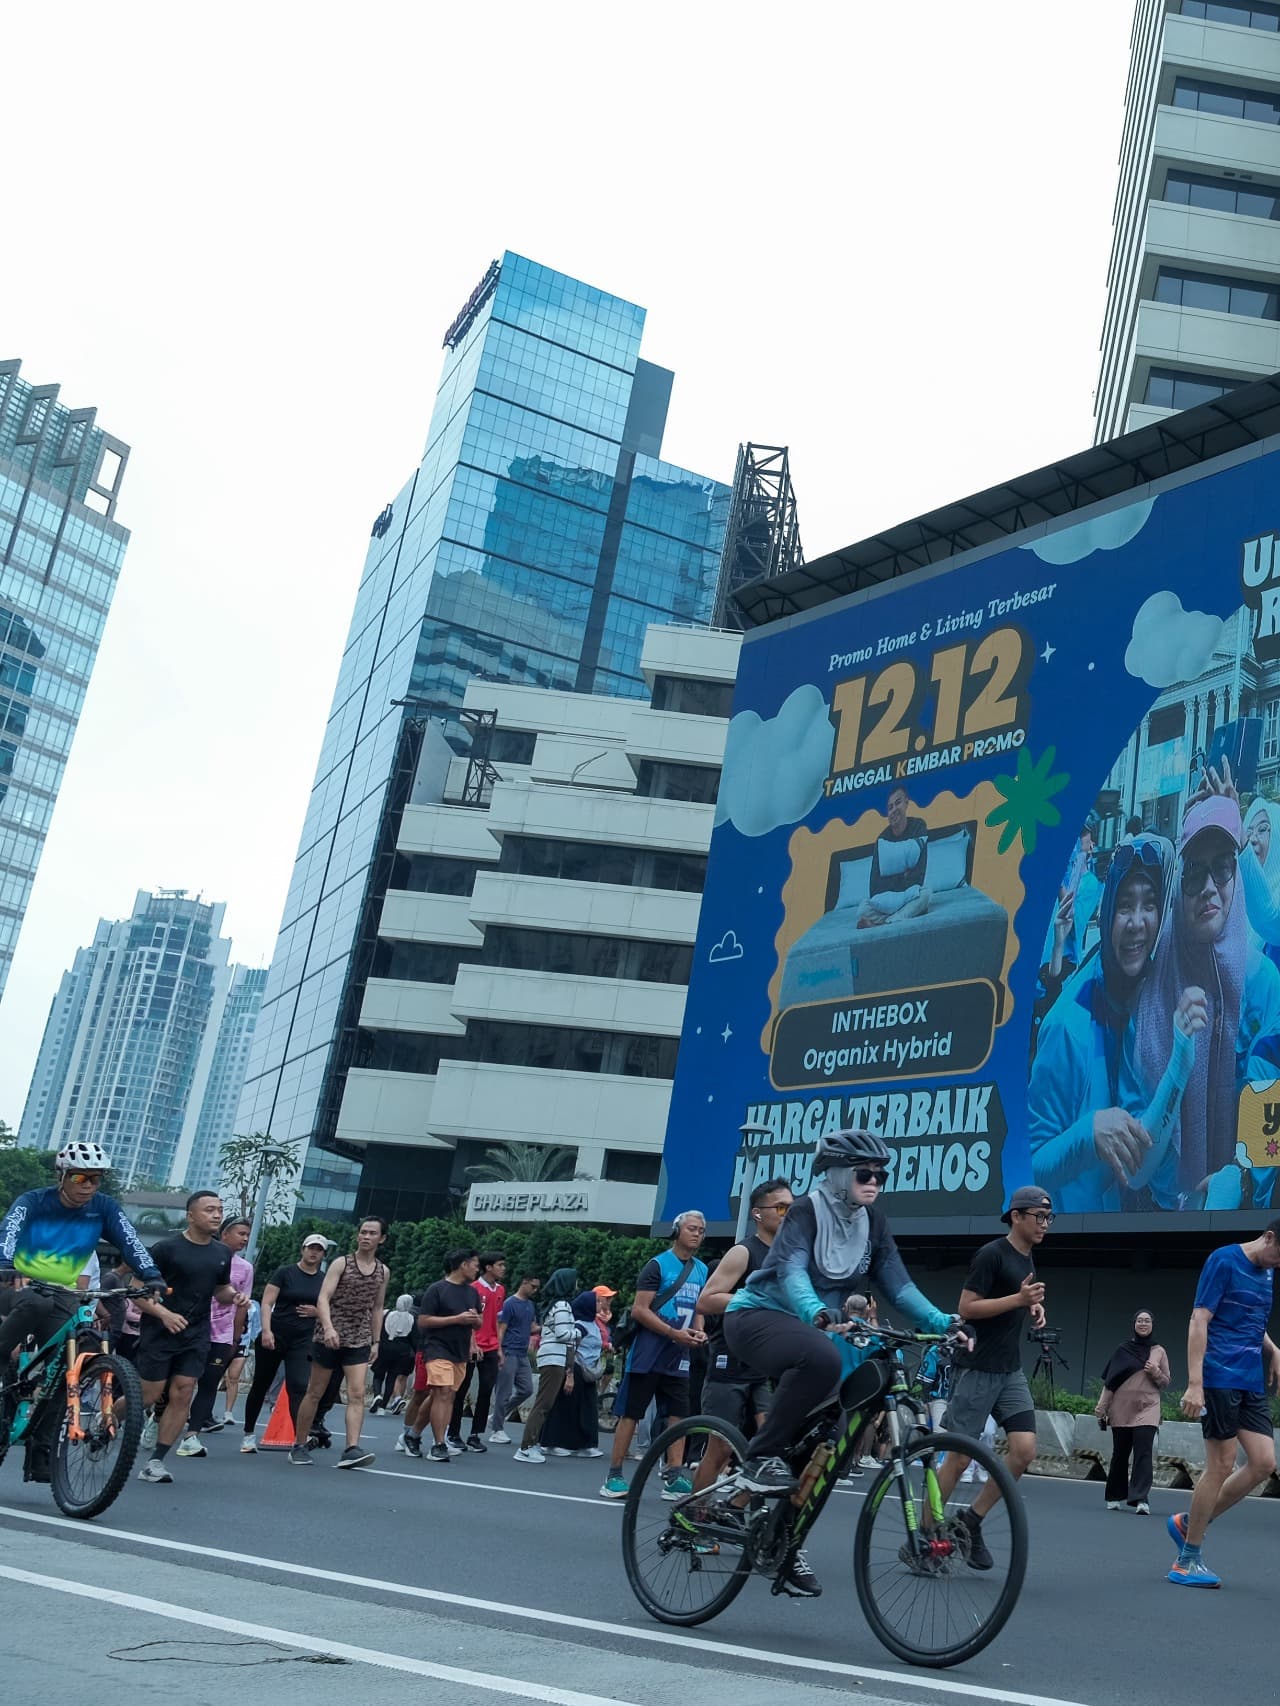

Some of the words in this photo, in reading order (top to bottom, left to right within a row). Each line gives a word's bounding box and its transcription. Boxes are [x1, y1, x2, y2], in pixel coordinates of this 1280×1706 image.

[827, 647, 873, 673] Promo
[875, 632, 917, 657] Home
[919, 623, 932, 641] &
[935, 609, 983, 637] Living
[988, 583, 1057, 619] Terbesar
[832, 628, 1023, 773] 12.12
[823, 763, 893, 798] TANGGAL
[895, 745, 962, 779] KEMBAR
[963, 729, 1026, 761] PROMO
[831, 999, 929, 1034] INTHEBOX
[803, 1041, 879, 1075] Organix
[882, 1032, 953, 1068] Hybrid
[742, 1099, 843, 1148] HARGA
[845, 1086, 994, 1138] TERBAIK
[472, 1192, 529, 1212] CHASE
[529, 1192, 589, 1212] PLAZA
